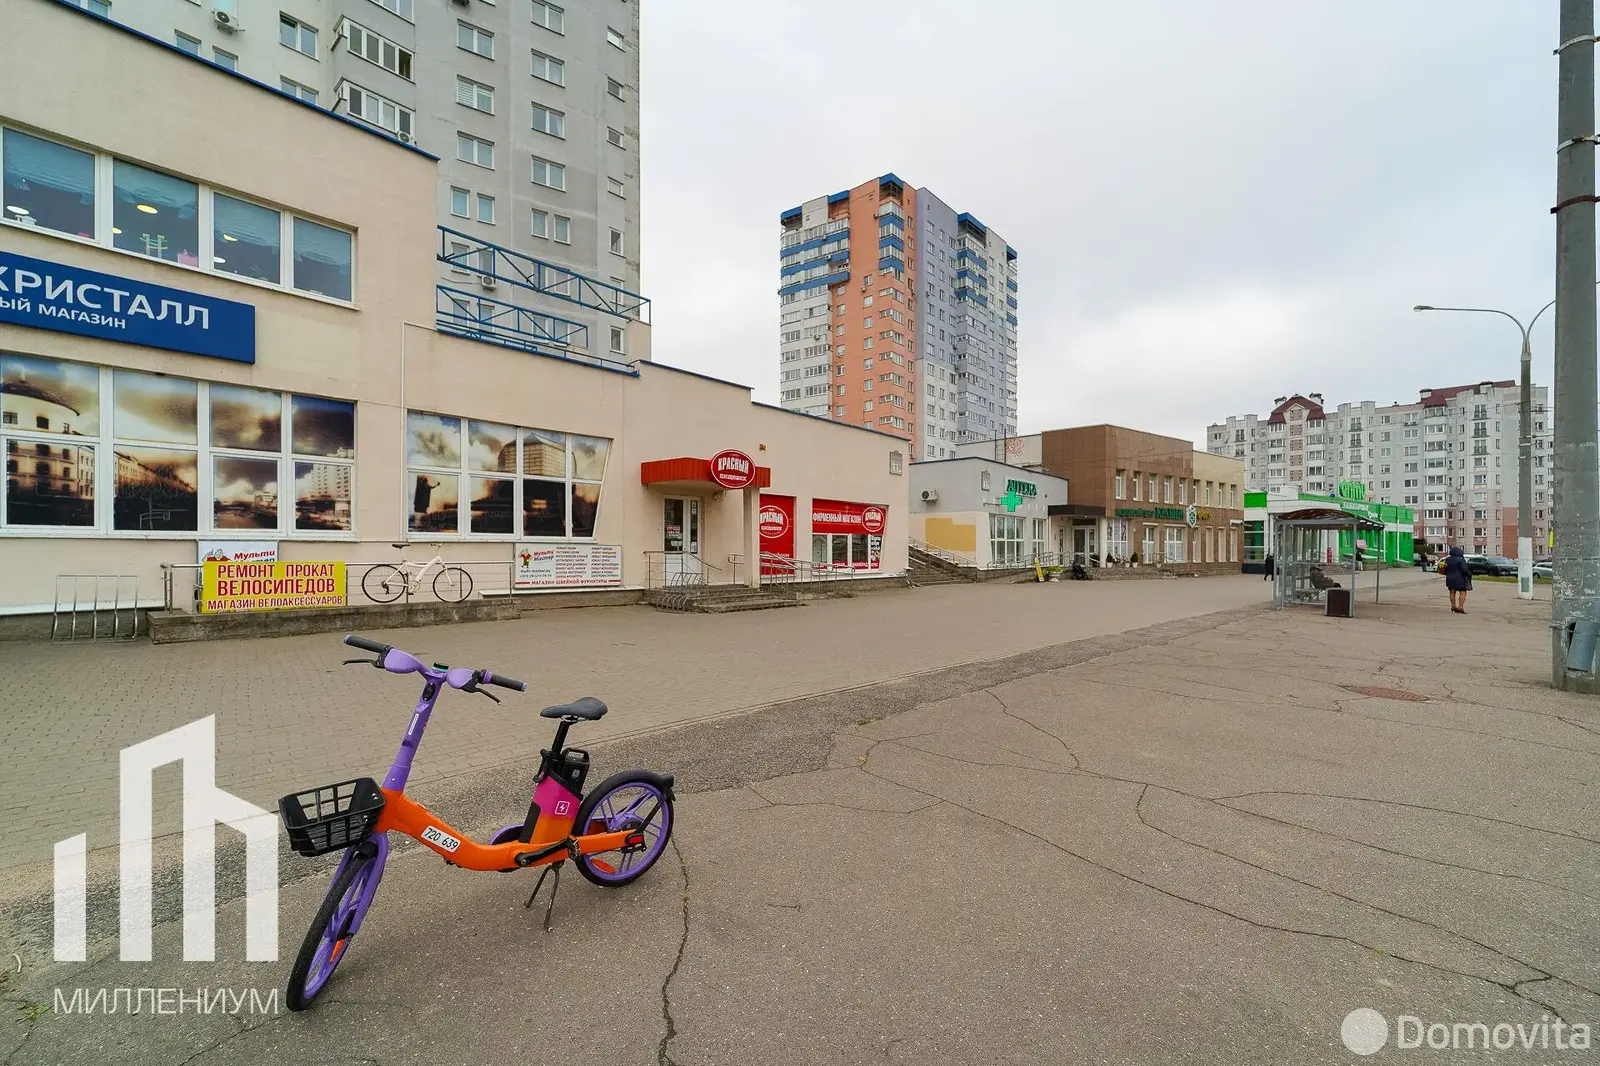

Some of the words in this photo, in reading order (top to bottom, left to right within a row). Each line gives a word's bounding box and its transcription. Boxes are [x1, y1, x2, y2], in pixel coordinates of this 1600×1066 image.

[38, 304, 126, 329] МАГАЗИН
[718, 457, 749, 475] КРАСНЫЙ
[1006, 479, 1037, 496] АПТЕКА
[233, 550, 276, 562] Мульти
[217, 564, 275, 579] РЕМОНТ
[285, 563, 335, 577] ПРОКАТ
[217, 578, 335, 597] ВЕЛОСИПЕДОВ
[207, 599, 256, 610] МАГАЗИН
[258, 595, 343, 608] ВЕЛОАКСЕССУАРОВ
[424, 827, 442, 842] 720
[441, 837, 459, 850] 639
